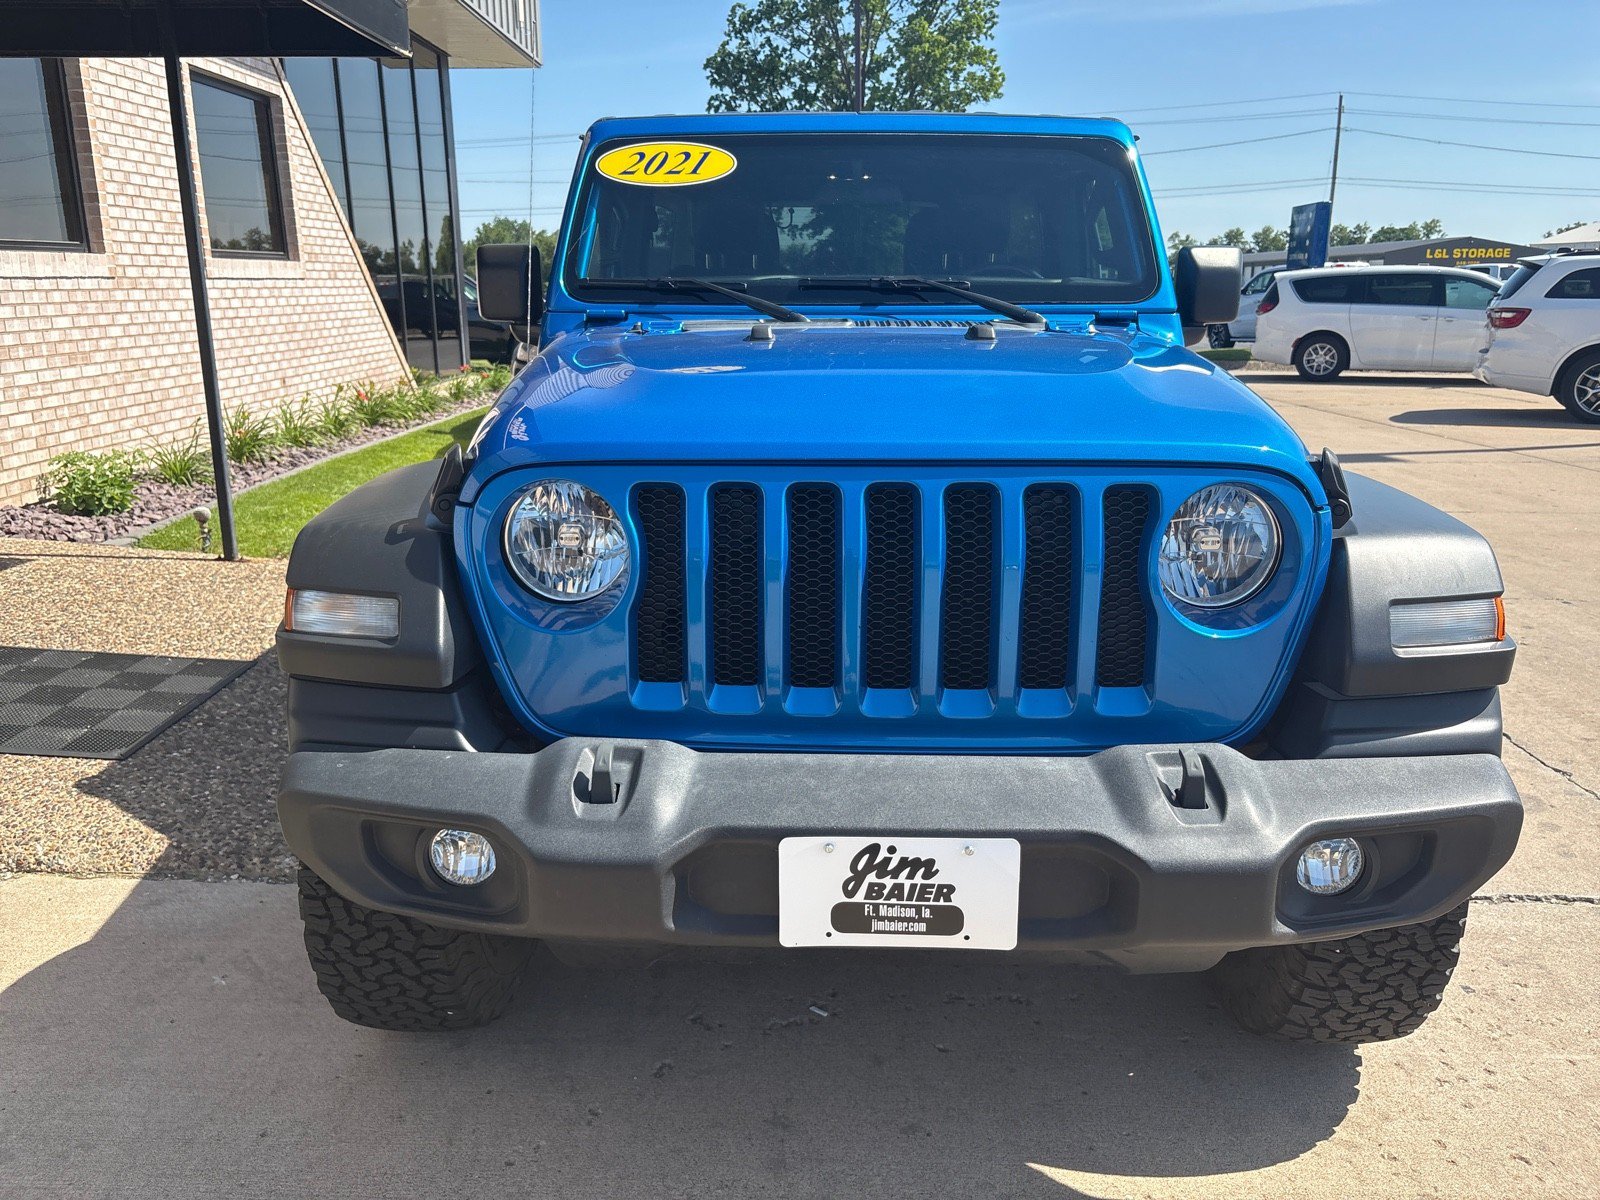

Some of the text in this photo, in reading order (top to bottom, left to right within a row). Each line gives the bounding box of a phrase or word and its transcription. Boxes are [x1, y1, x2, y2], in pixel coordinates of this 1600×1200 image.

[618, 150, 712, 176] 2021
[1426, 248, 1511, 259] L&L STORAGE
[842, 842, 940, 899] Jim
[863, 881, 957, 903] BAIER
[864, 904, 876, 917] Ft.
[879, 904, 919, 920] Madison,
[871, 918, 927, 933] jimbaier.com
